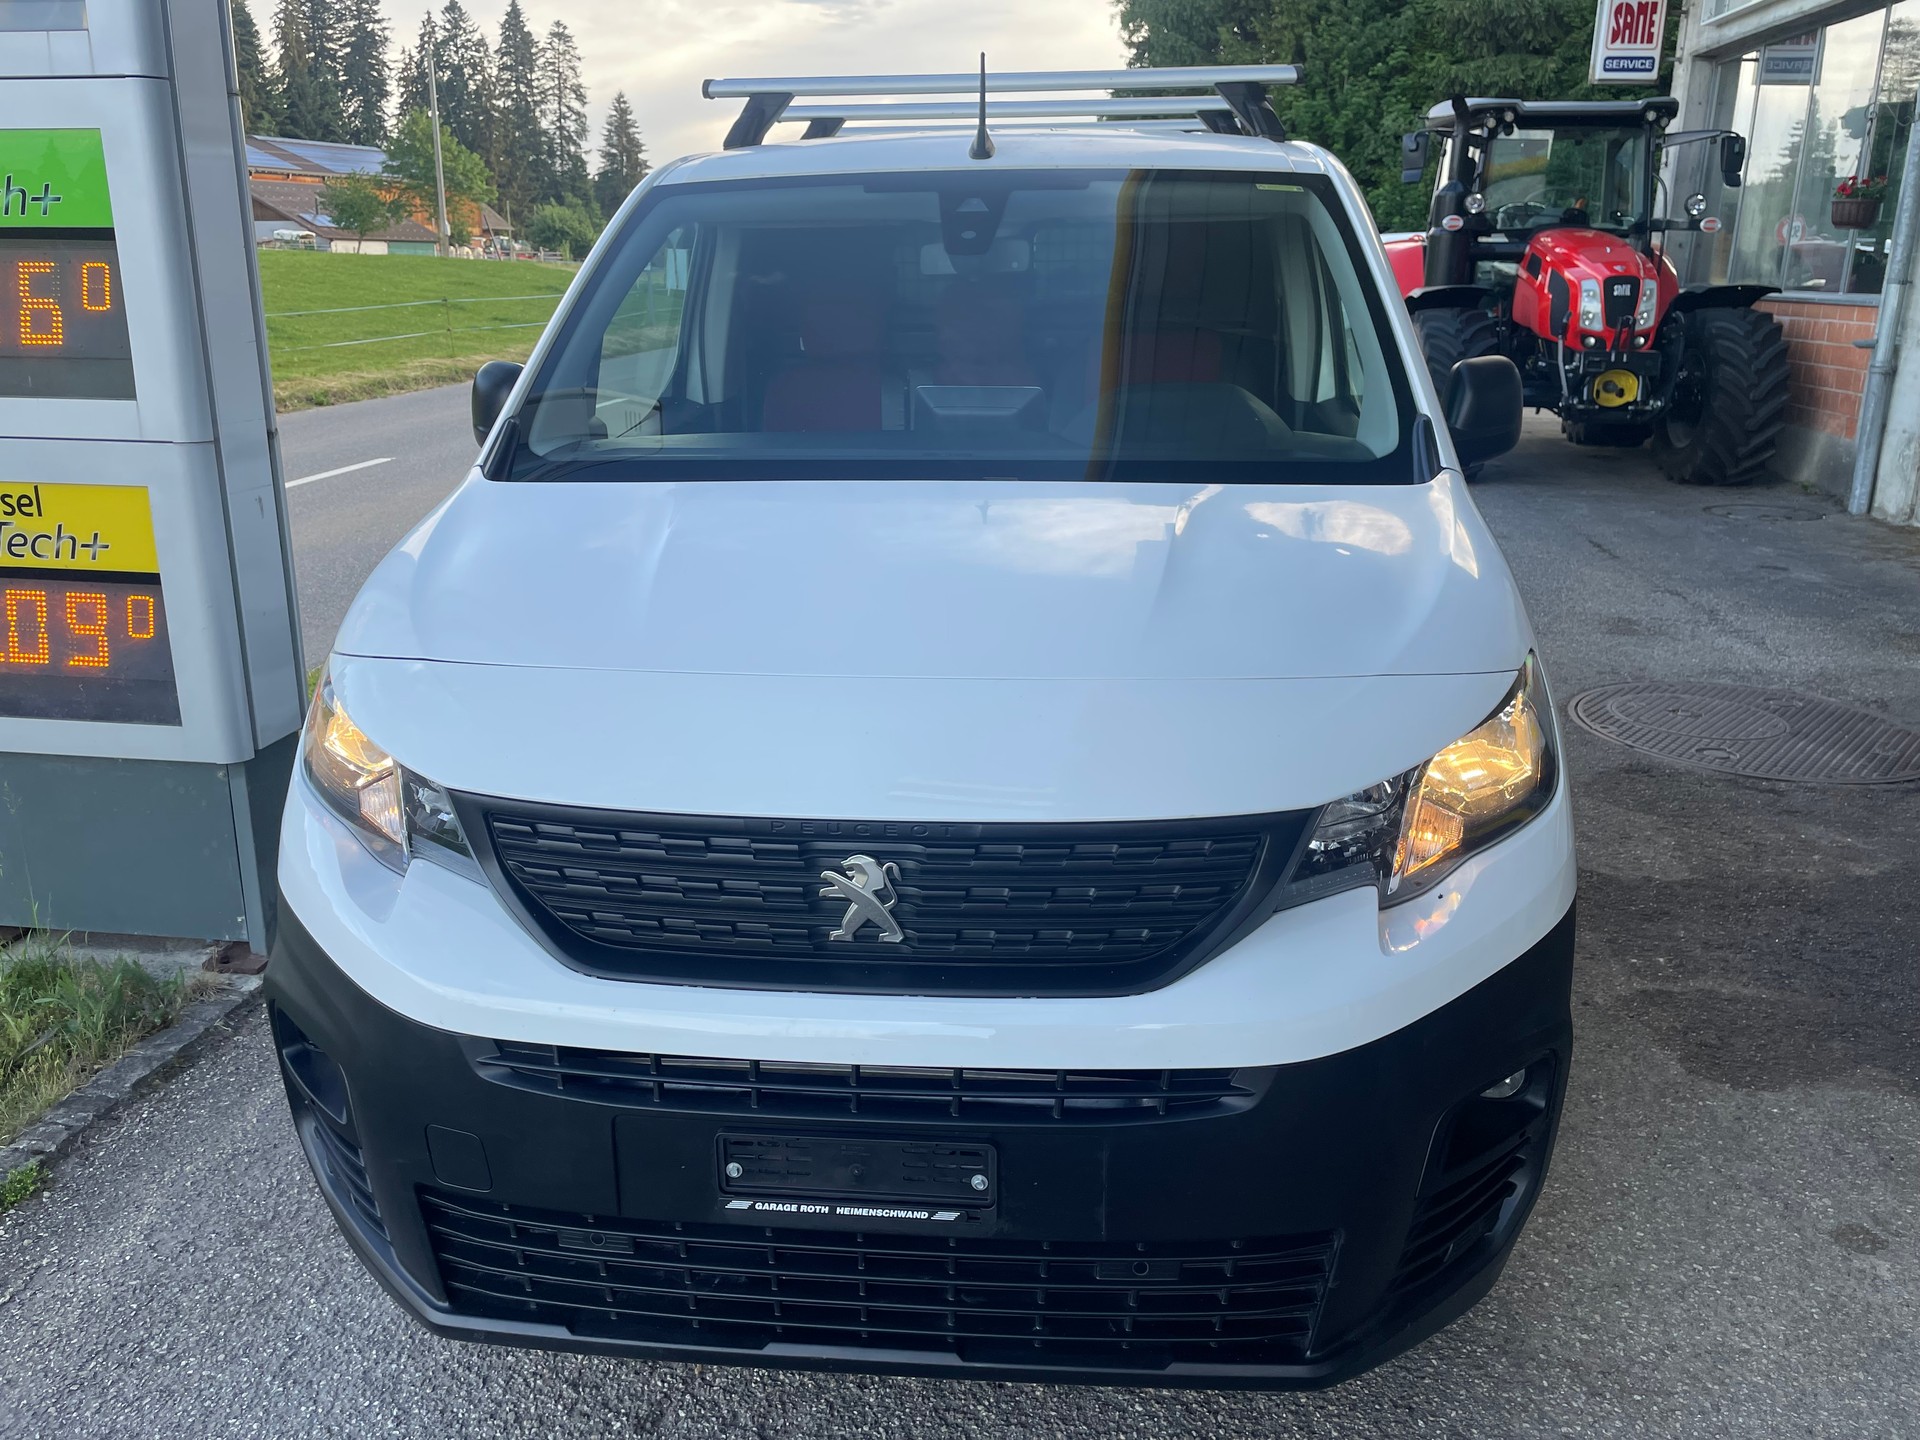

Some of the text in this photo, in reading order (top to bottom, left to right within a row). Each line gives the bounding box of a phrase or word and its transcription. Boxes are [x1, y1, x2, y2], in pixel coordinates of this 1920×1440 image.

[1610, 1, 1659, 45] SAME
[1605, 59, 1653, 69] SERVICE
[0, 174, 62, 216] h+
[770, 820, 955, 838] PEUGEOT
[754, 1202, 929, 1219] GARAGE ROTH HEIMENSCHWAND
